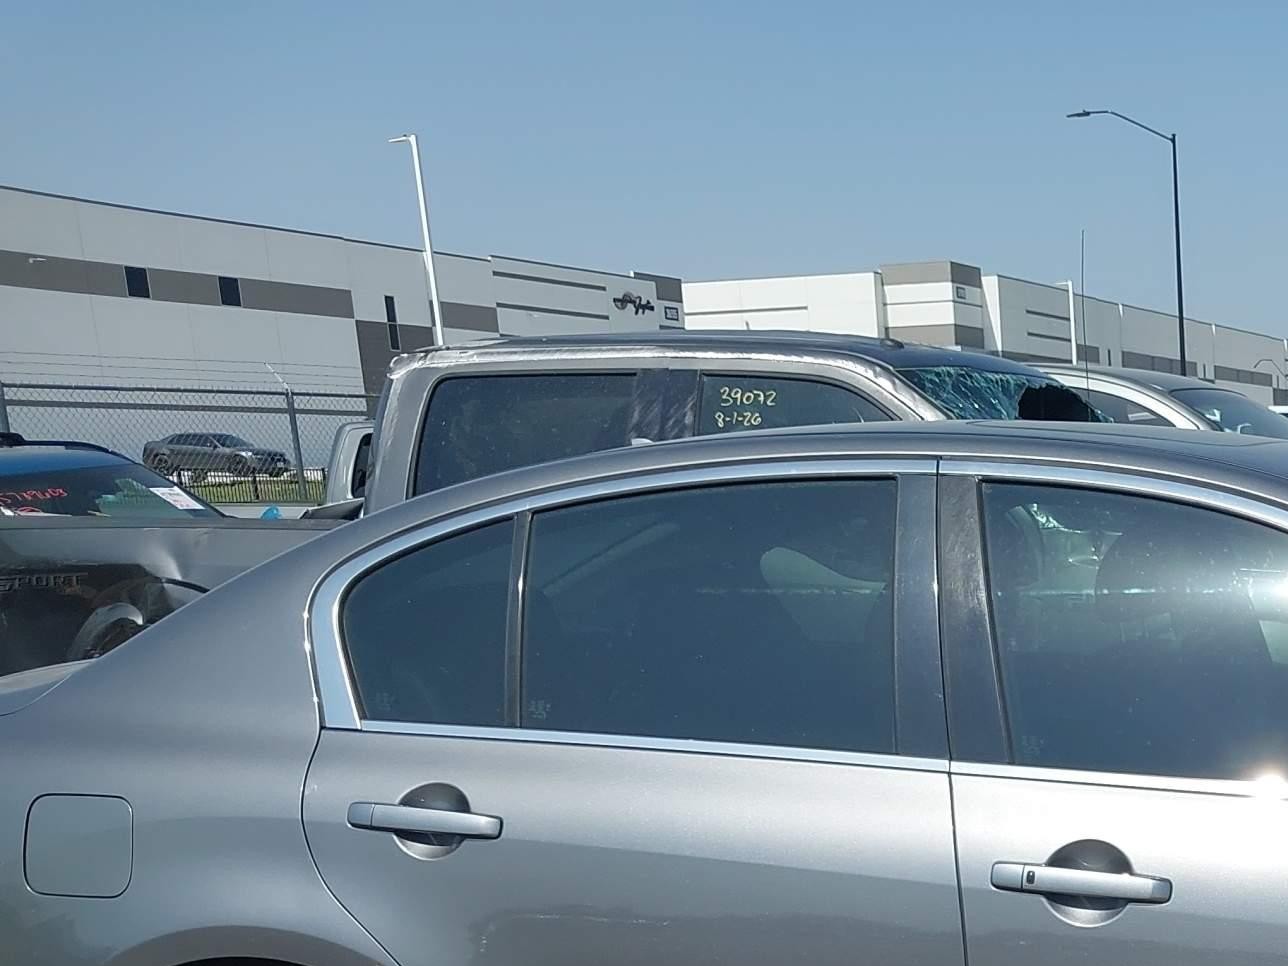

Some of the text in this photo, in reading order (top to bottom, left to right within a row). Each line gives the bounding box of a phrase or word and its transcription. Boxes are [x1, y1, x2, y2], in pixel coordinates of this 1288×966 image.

[720, 387, 776, 406] 39072
[715, 411, 762, 428] 8-1-26
[0, 574, 81, 593] SPORT
